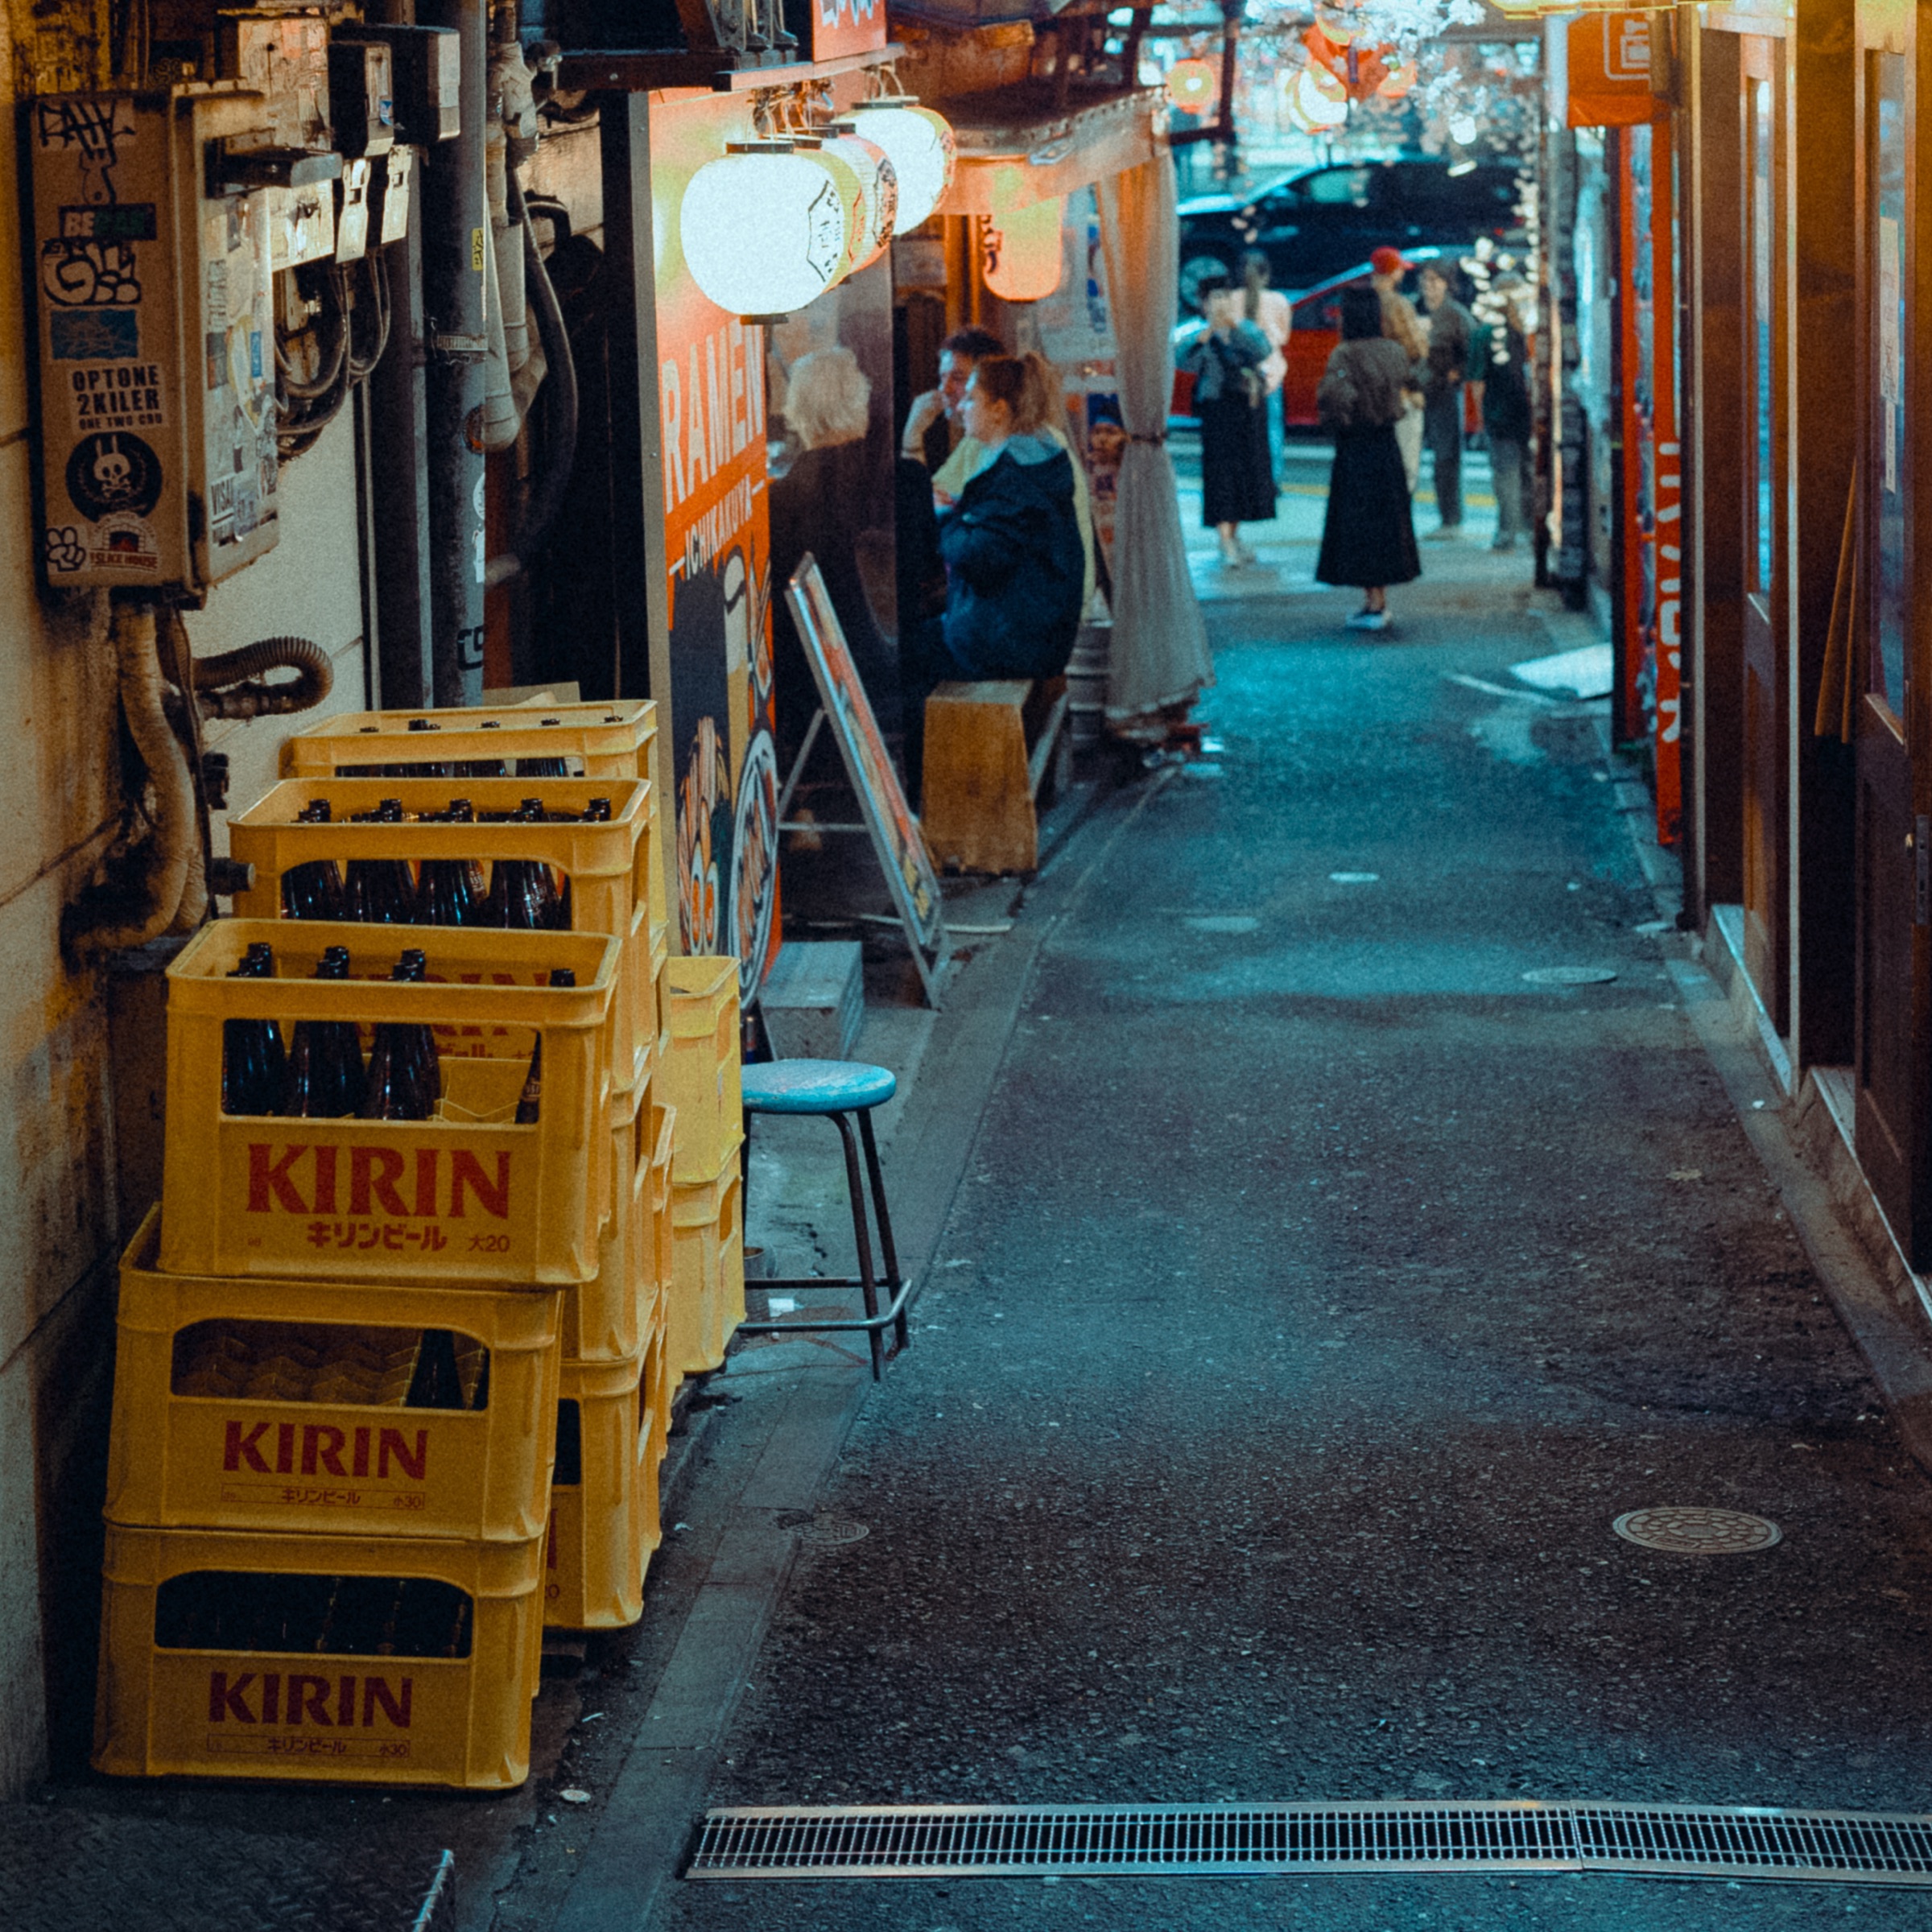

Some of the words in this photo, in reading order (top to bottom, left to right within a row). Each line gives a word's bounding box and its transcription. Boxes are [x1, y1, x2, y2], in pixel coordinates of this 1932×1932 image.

[72, 365, 159, 391] OPTONE
[77, 389, 159, 415] 2KILER
[662, 317, 763, 514] RAMEN
[79, 418, 101, 430] ONE
[107, 415, 134, 427] TWO
[246, 1143, 511, 1220] KIRIN
[307, 1221, 448, 1252] キリンビール
[468, 1235, 510, 1253] 大20
[223, 1420, 428, 1480] KIRIN
[282, 1488, 361, 1505] キリンビール
[208, 1670, 413, 1729] KIRIN
[268, 1736, 347, 1755] キリンビール
